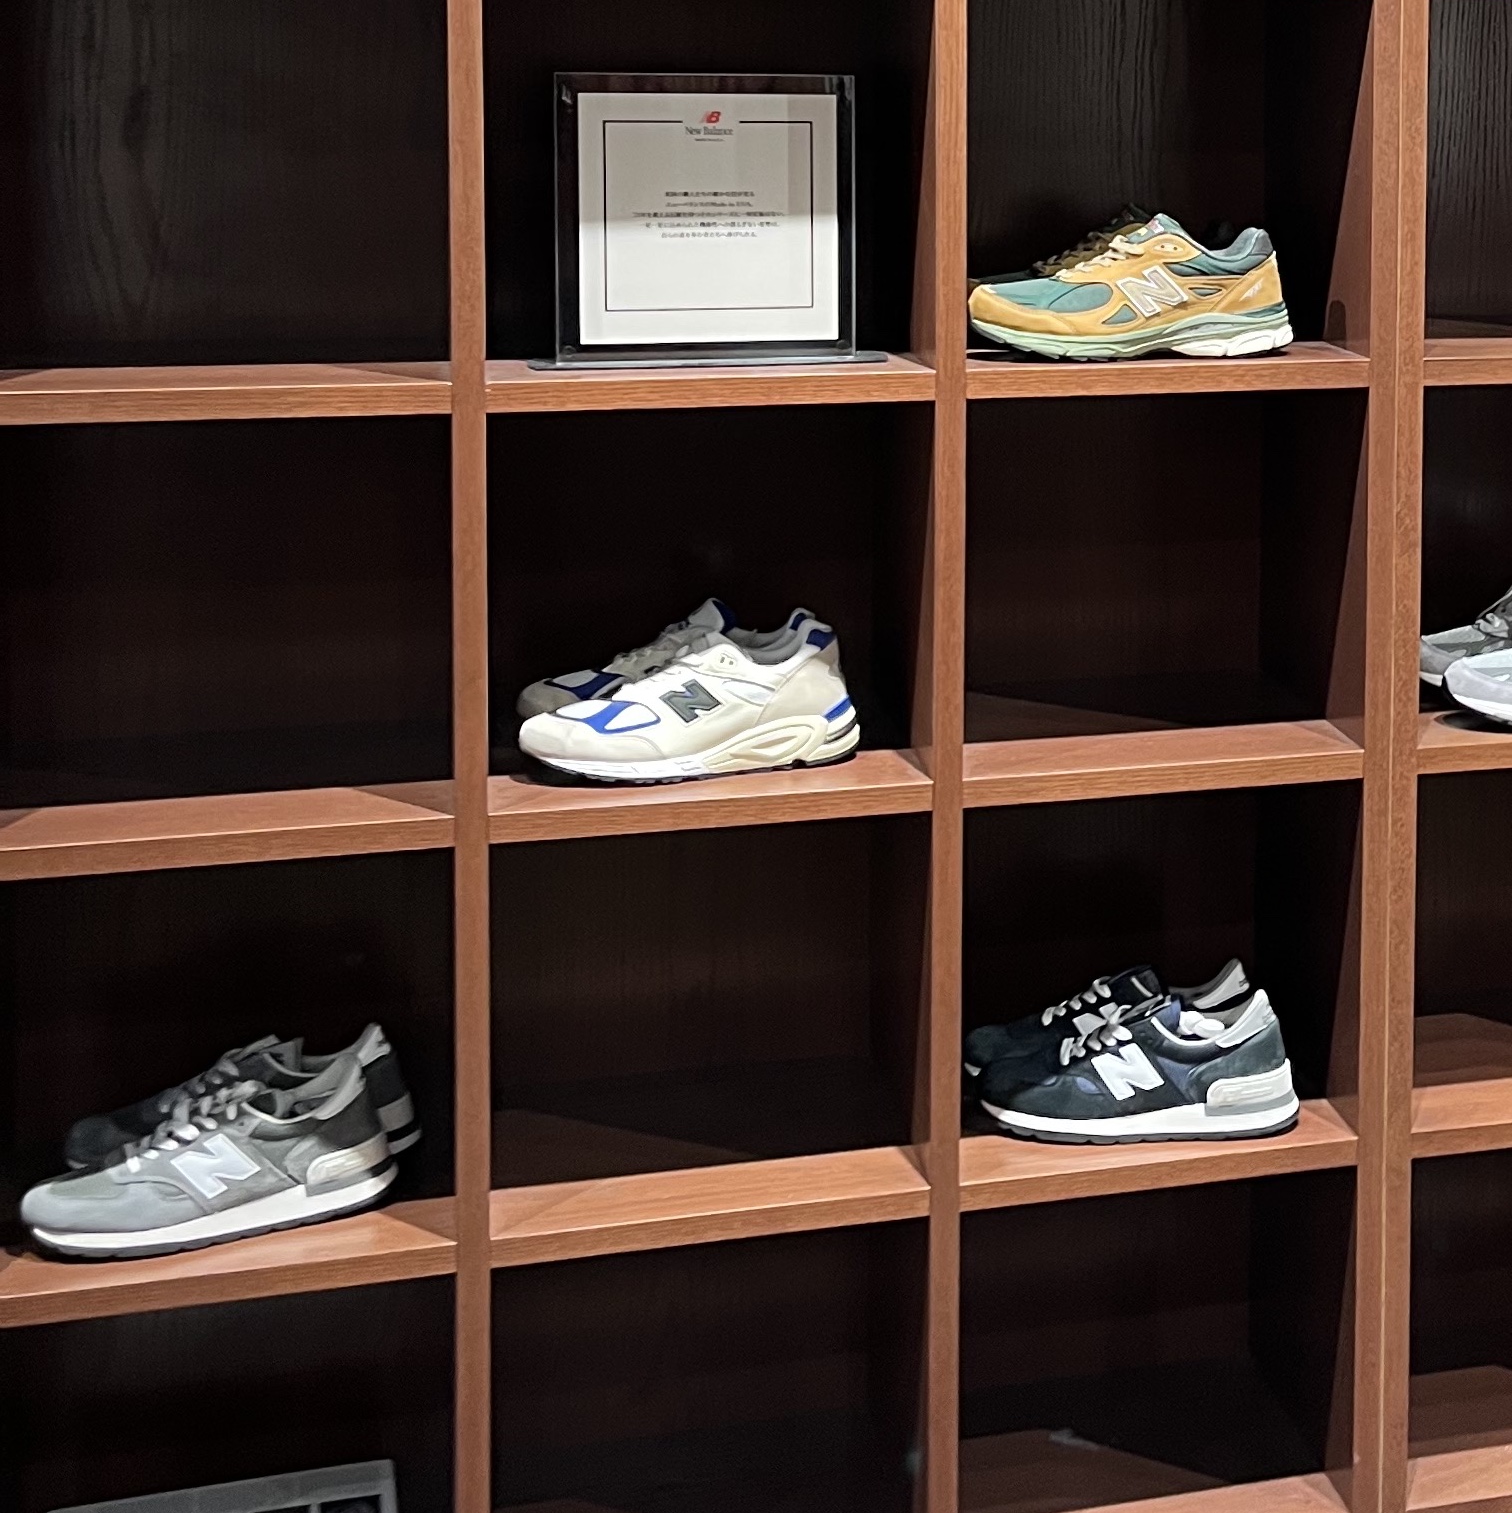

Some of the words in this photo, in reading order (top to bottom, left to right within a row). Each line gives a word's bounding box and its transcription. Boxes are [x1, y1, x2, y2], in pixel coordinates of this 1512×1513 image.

[1114, 265, 1189, 318] N
[660, 678, 722, 724] N
[1090, 1042, 1165, 1101] N
[170, 1133, 261, 1199] N
